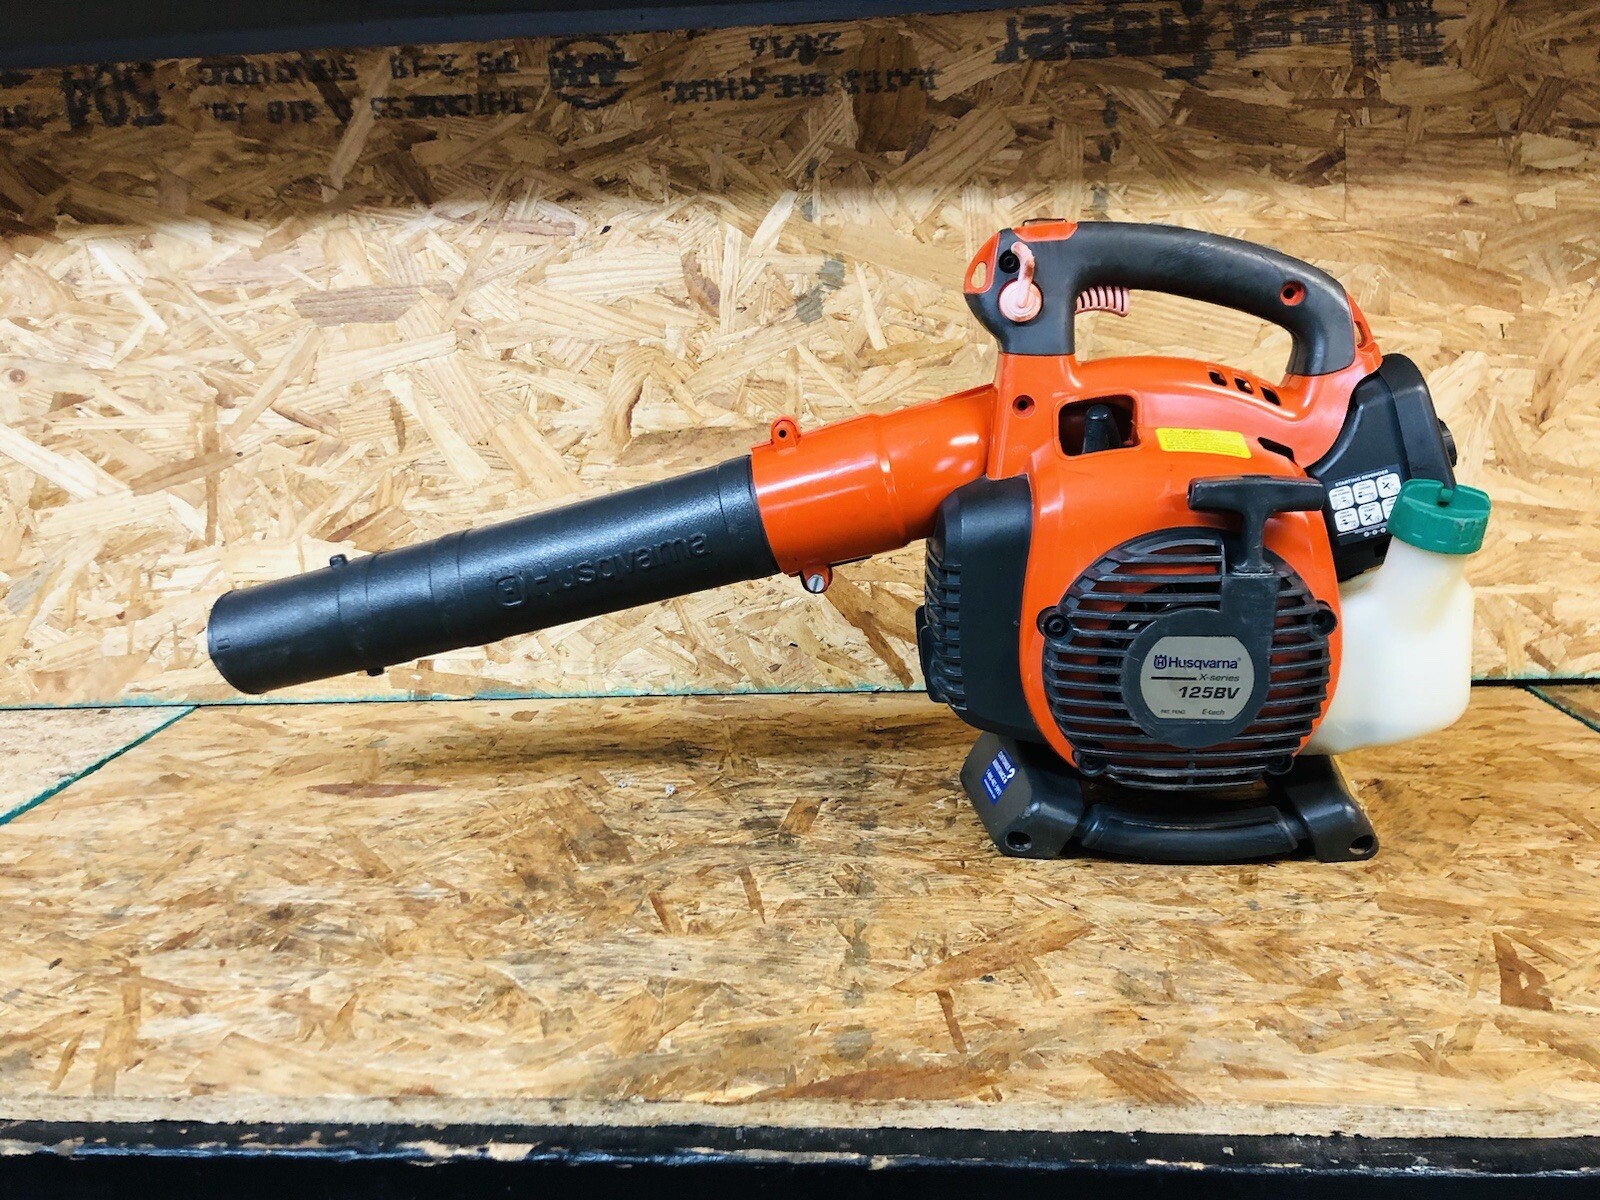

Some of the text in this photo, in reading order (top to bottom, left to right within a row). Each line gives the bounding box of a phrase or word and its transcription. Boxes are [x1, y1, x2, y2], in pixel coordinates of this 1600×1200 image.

[1168, 656, 1238, 670] Husqvarna
[1199, 673, 1240, 682] X-series
[1179, 686, 1241, 699] 125BV
[1202, 708, 1225, 716] E-tech
